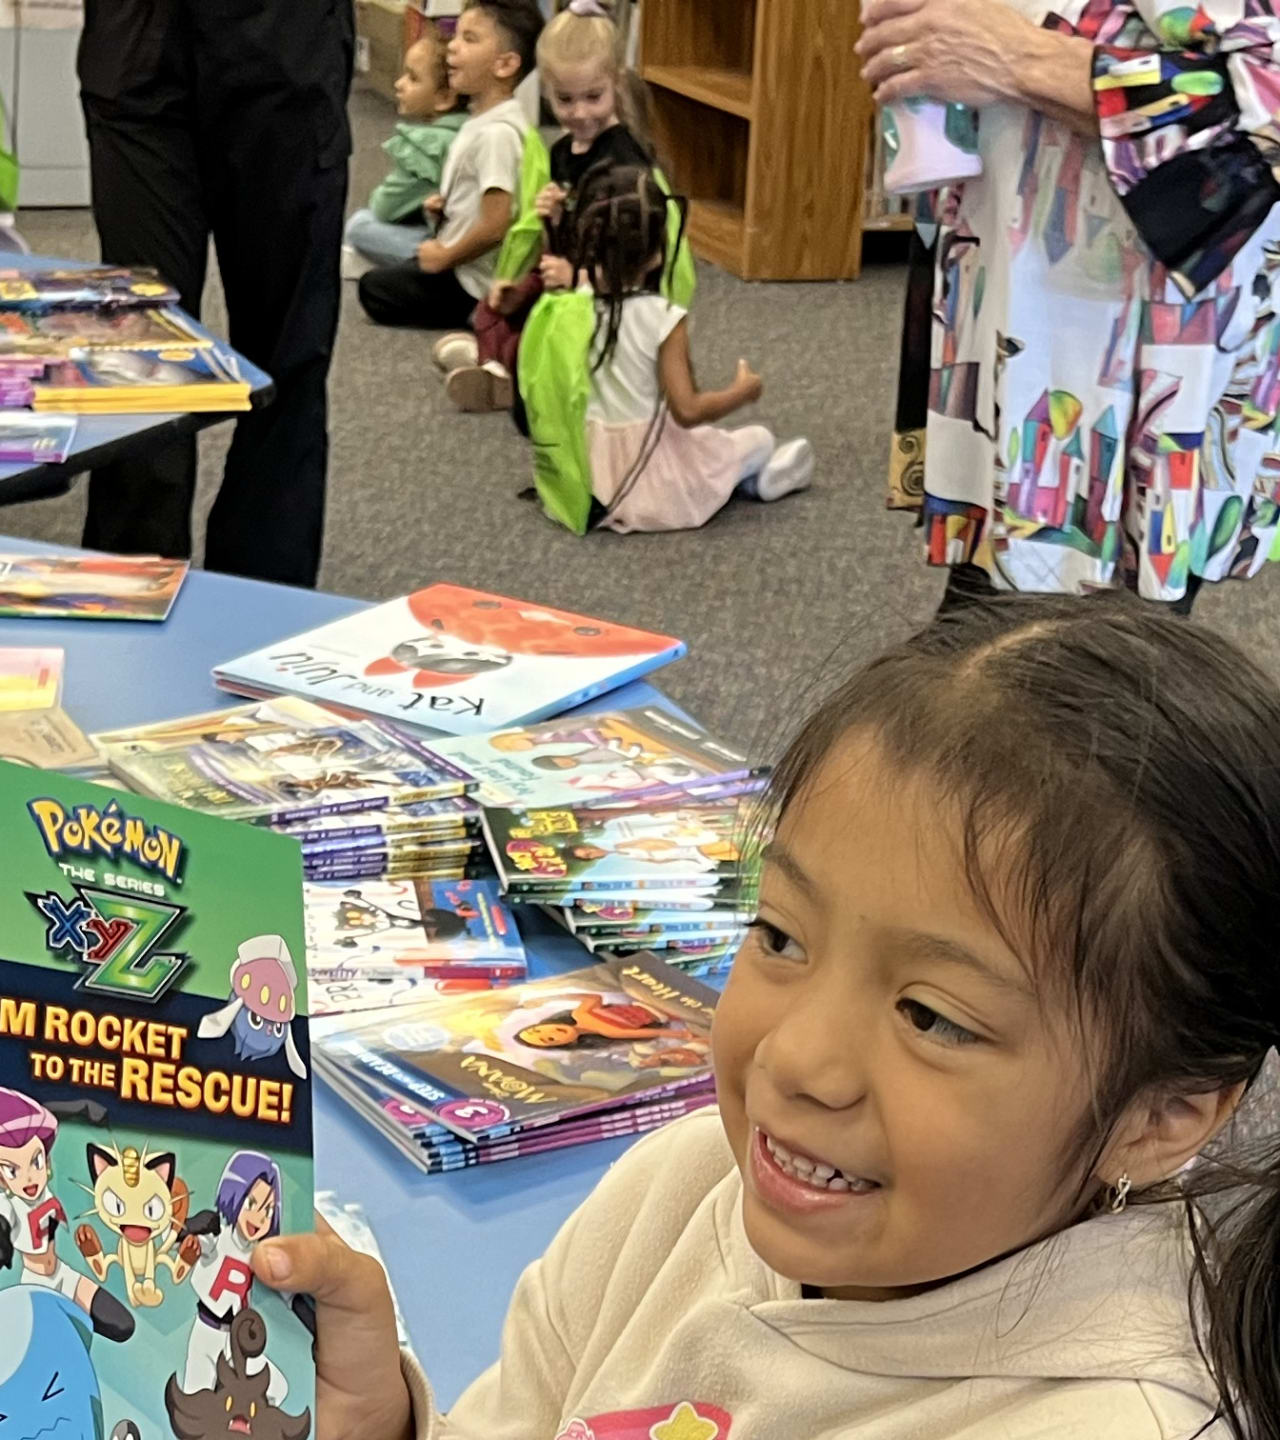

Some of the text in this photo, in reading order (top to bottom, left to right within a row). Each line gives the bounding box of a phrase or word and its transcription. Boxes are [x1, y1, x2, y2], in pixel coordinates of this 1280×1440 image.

[342, 681, 395, 700] and
[399, 692, 486, 717] Kat
[58, 862, 166, 898] THE SERIES
[622, 965, 681, 1001] Heart
[43, 1006, 188, 1060] ROCKET
[30, 1051, 295, 1124] TO THE RESCUE!
[460, 1055, 558, 1104] MOANA
[209, 1255, 253, 1310] R
